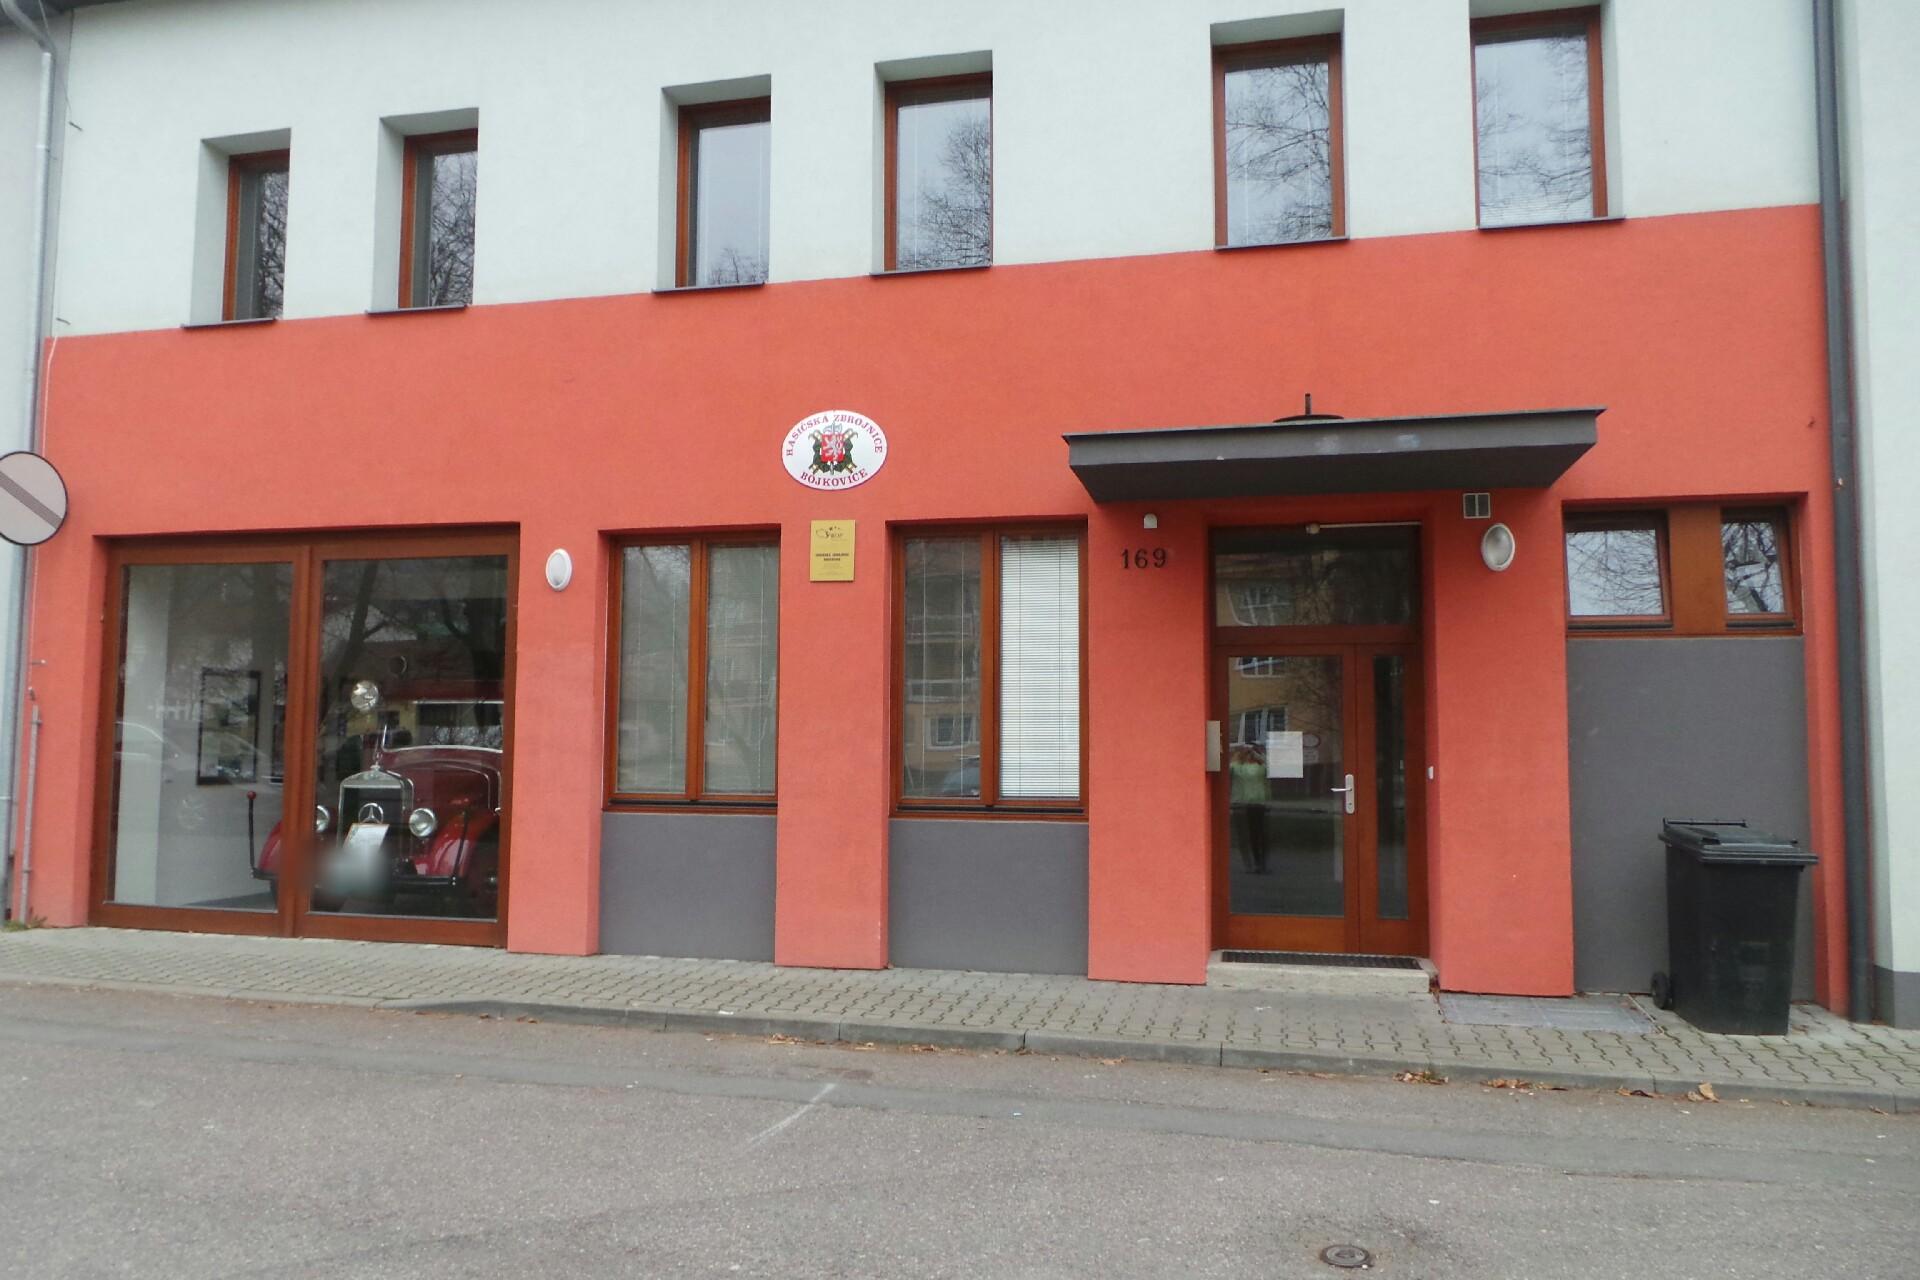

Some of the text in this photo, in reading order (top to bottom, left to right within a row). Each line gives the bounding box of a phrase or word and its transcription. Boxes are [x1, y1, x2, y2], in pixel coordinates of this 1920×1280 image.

[834, 414, 883, 454] ZBROJNICE
[800, 468, 868, 487] BOJKOVICE
[1122, 548, 1167, 569] 169
